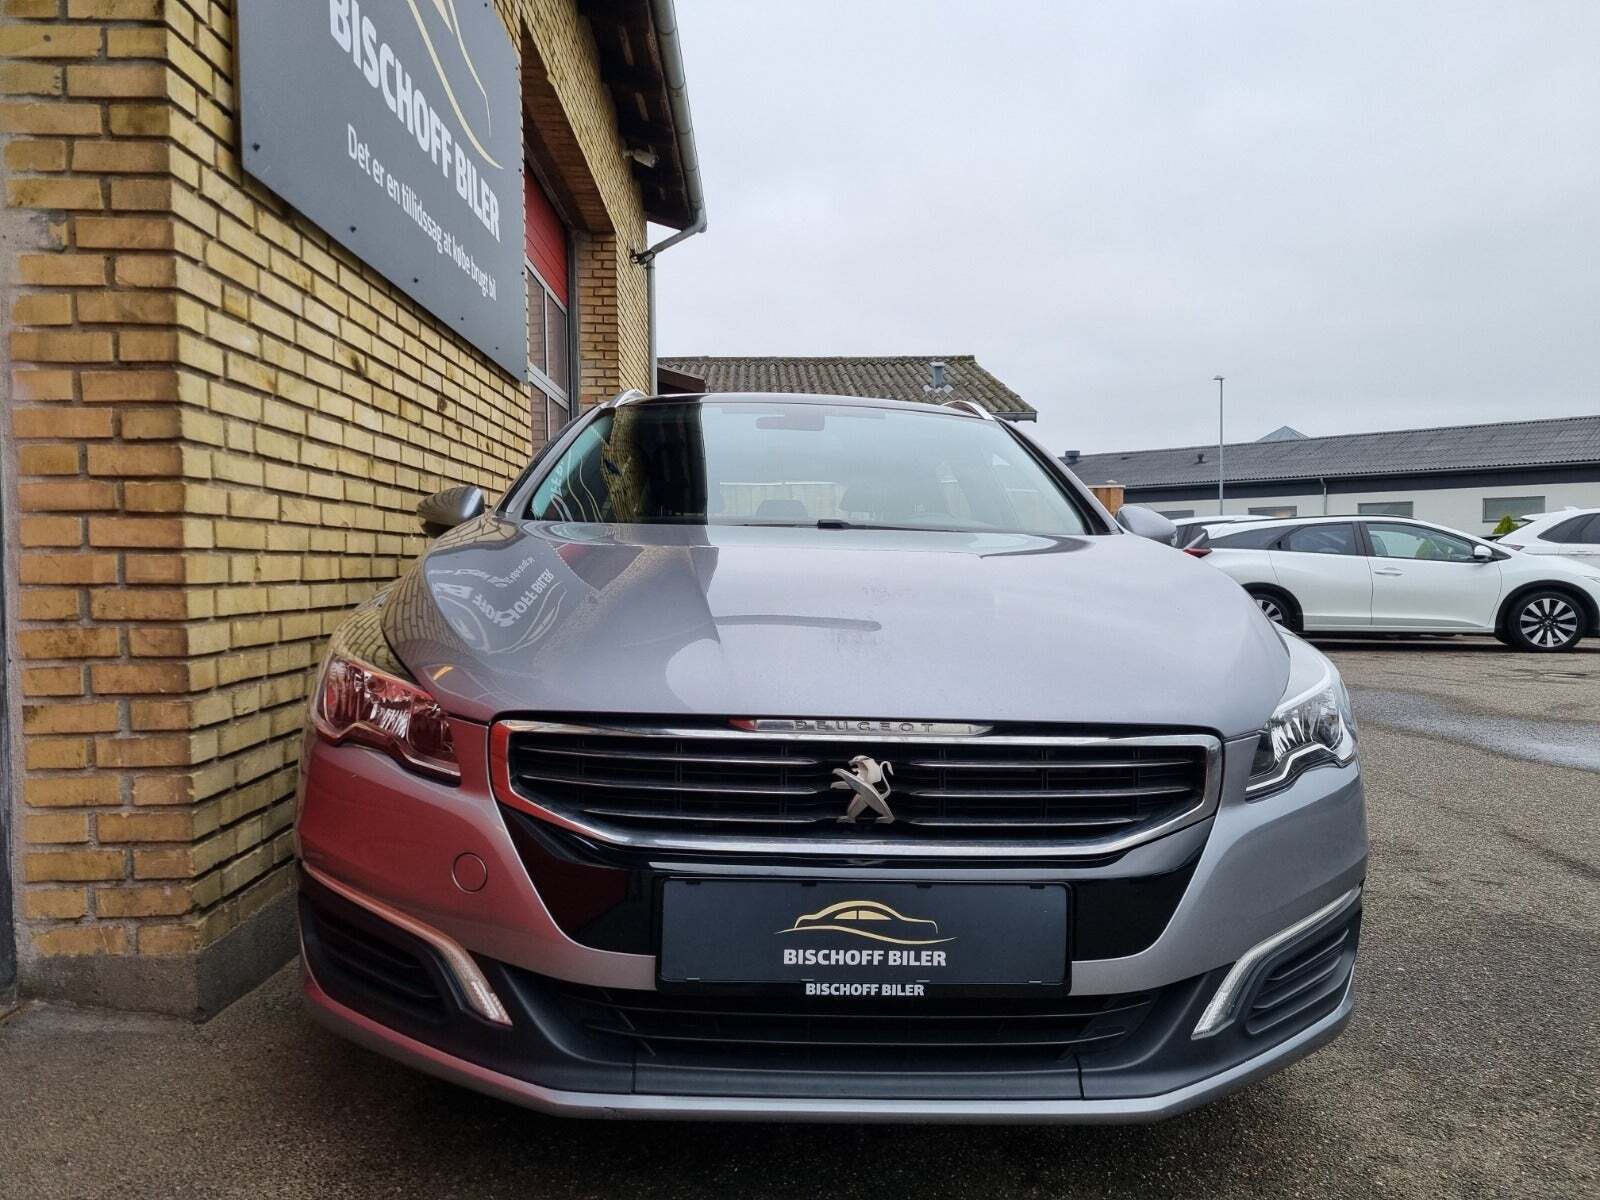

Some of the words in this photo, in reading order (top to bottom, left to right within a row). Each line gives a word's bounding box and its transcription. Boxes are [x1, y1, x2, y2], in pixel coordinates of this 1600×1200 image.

[329, 0, 452, 178] BISCHOFF
[454, 142, 500, 243] BILER
[347, 123, 371, 176] Det
[372, 158, 385, 188] er
[386, 173, 401, 205] en
[401, 183, 443, 255] tillidssag
[443, 231, 452, 257] at
[488, 273, 497, 302] bil
[792, 720, 934, 733] PEUGEOT
[783, 949, 885, 966] BISCHOFF
[887, 950, 947, 967] BILER
[805, 983, 879, 996] BISCHOFF
[881, 984, 925, 997] BILER
